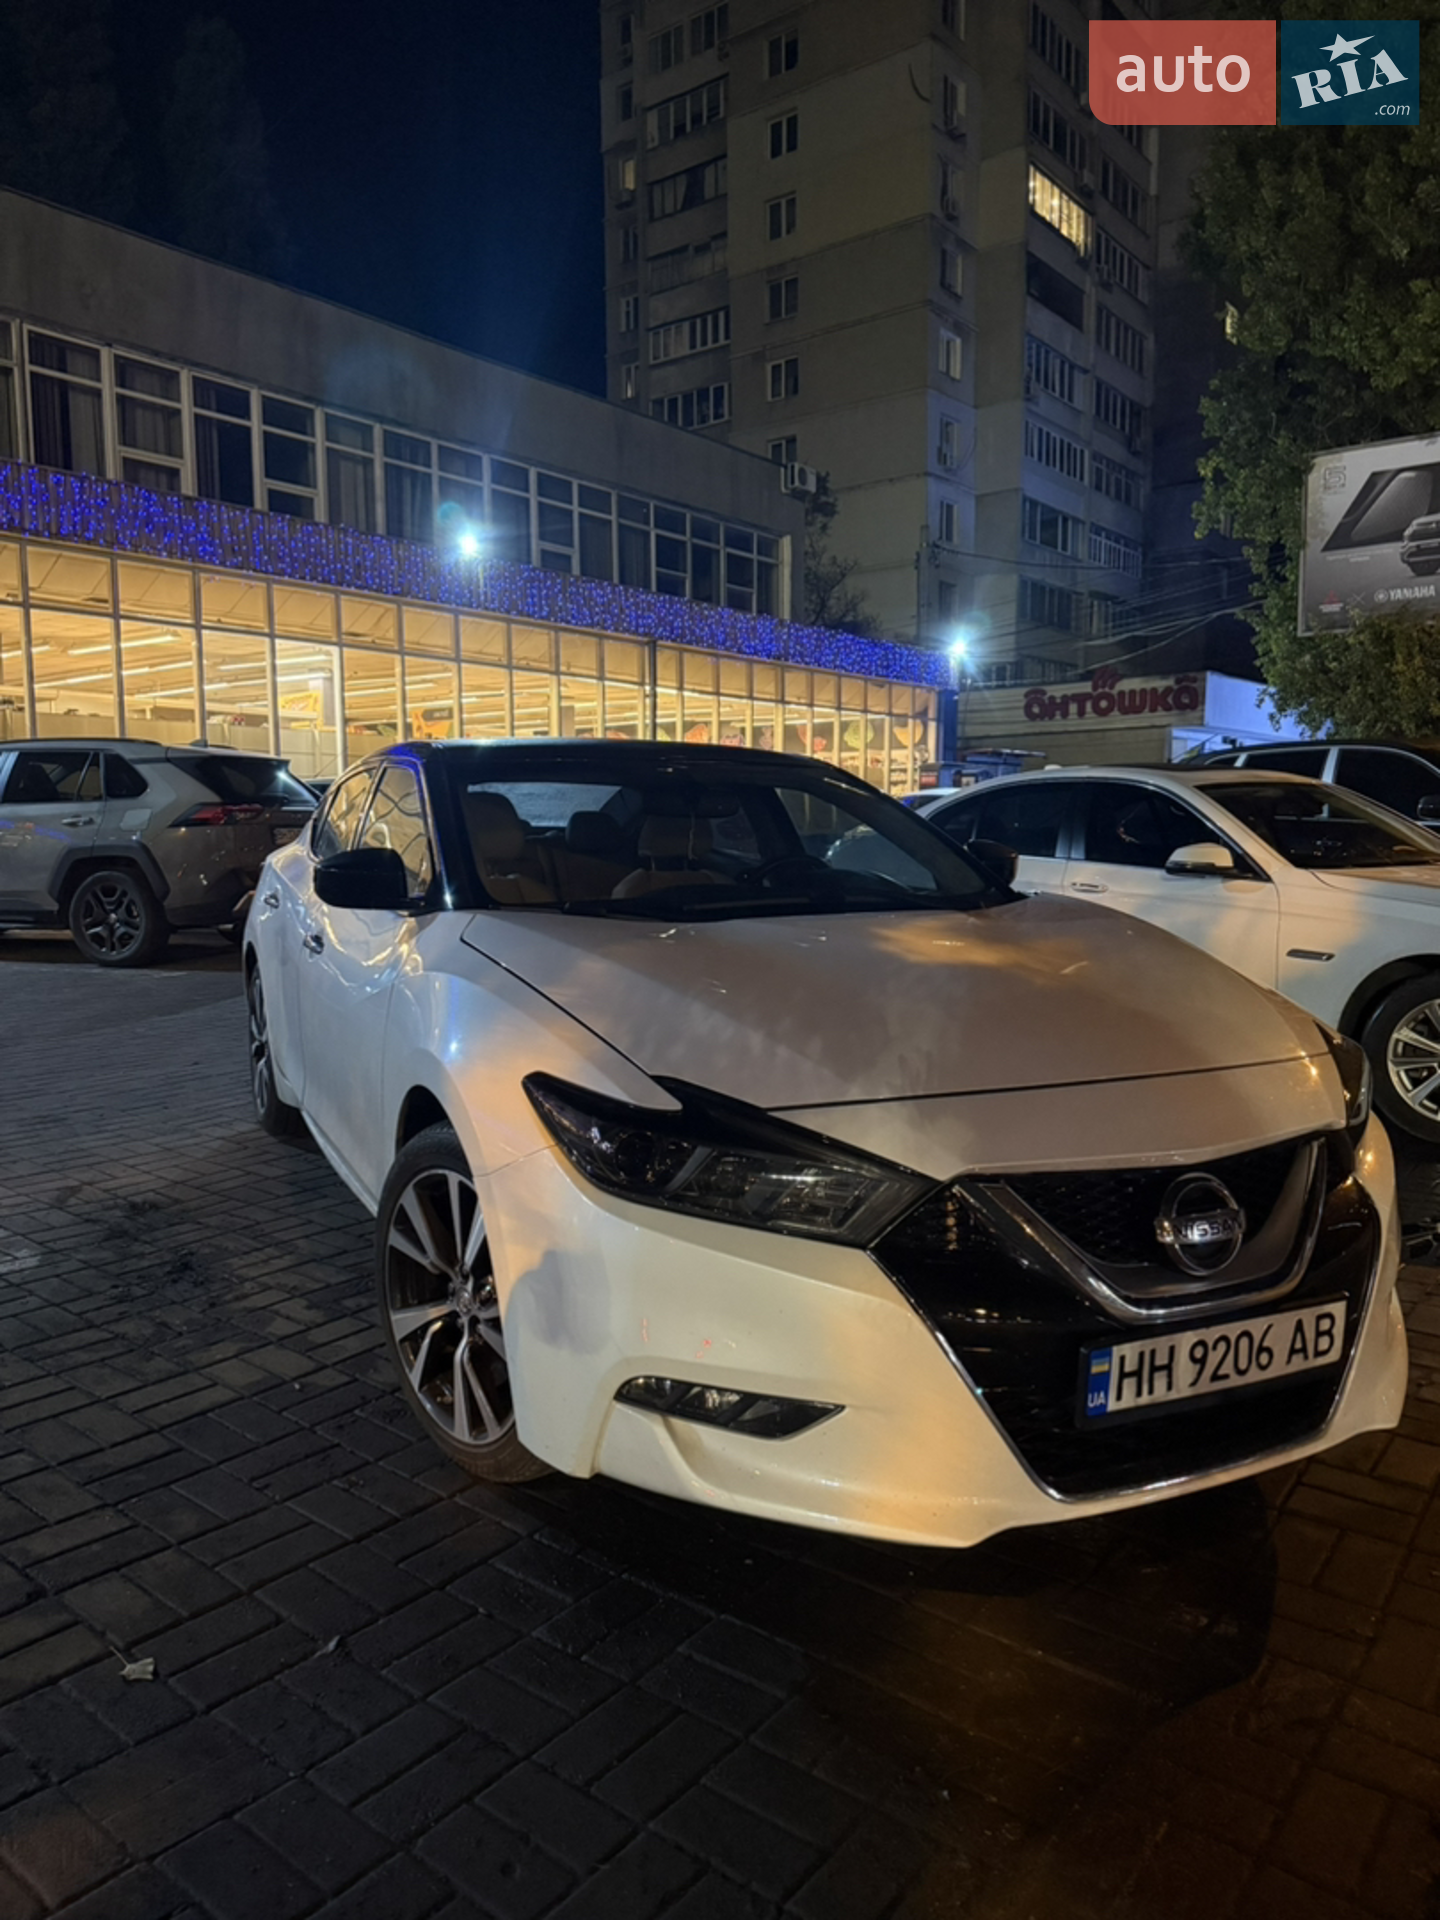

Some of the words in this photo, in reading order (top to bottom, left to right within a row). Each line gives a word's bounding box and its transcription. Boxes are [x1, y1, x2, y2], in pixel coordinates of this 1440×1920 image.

[1389, 585, 1436, 601] YAMAHA
[1115, 1344, 1176, 1402] HH
[1188, 1323, 1274, 1388] 9206
[1286, 1311, 1336, 1366] AB
[1087, 1391, 1106, 1408] UA
